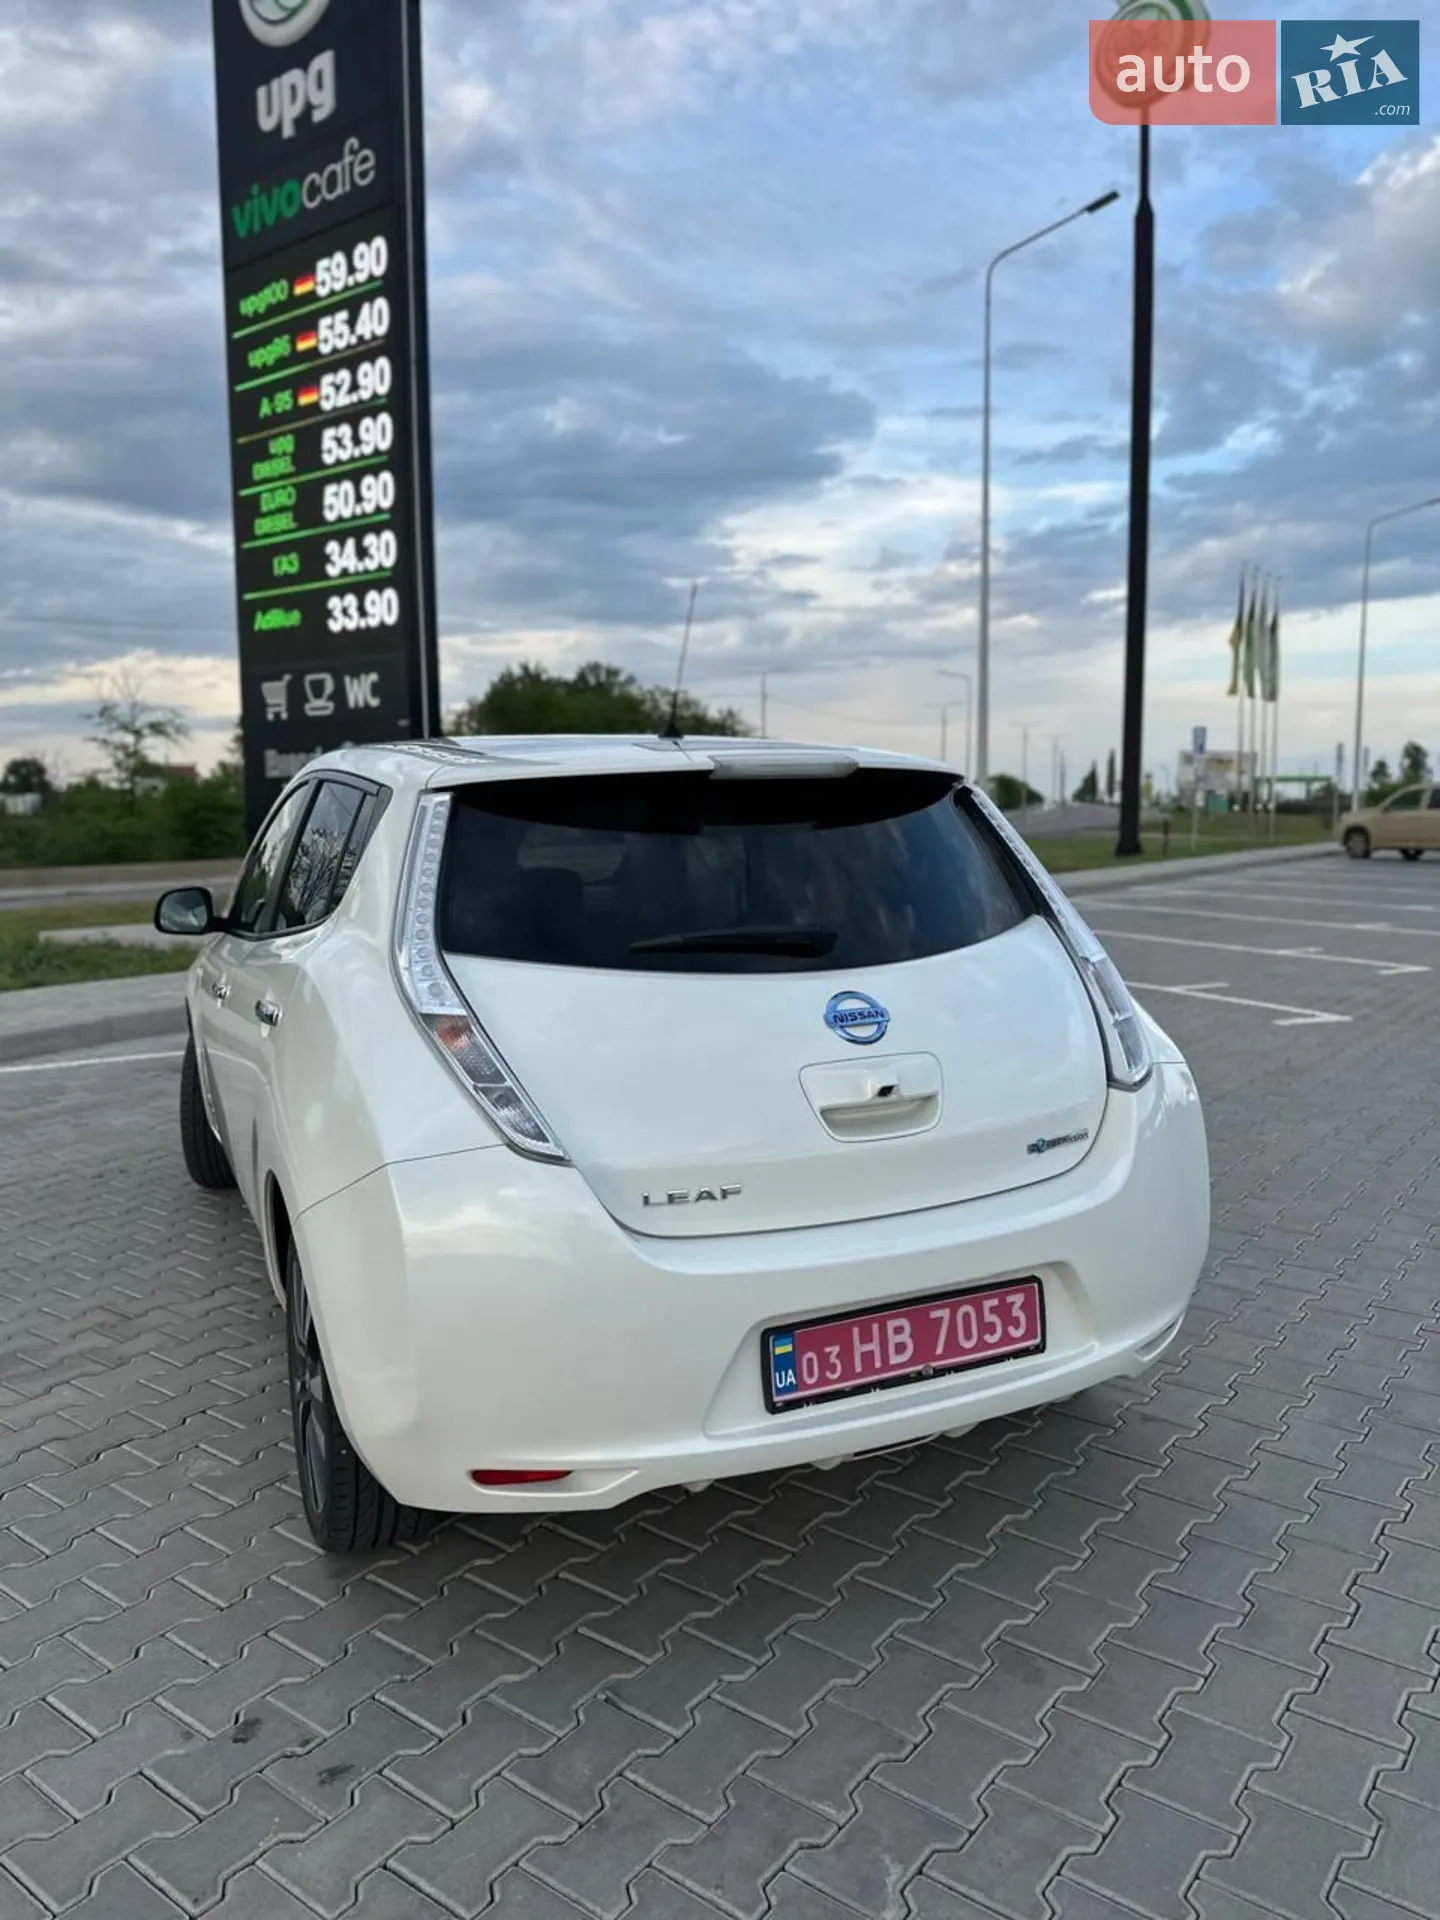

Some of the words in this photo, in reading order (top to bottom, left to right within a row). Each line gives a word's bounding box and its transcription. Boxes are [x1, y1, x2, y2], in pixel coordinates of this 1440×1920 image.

[256, 50, 335, 139] upg
[232, 137, 376, 239] vivocafe
[315, 235, 388, 297] 59.90
[318, 296, 390, 354] 55.40
[319, 355, 392, 412] 52.90
[321, 411, 394, 466] 53.90
[322, 470, 396, 523] 50.90
[324, 529, 398, 578] 34.30
[326, 587, 399, 634] 33.90
[344, 671, 381, 709] WC
[833, 1009, 885, 1024] NISSAN
[642, 1183, 743, 1207] LEAF
[775, 1368, 796, 1388] UA
[802, 1345, 843, 1385] 03
[852, 1317, 914, 1374] HB
[929, 1292, 1028, 1356] 7053
